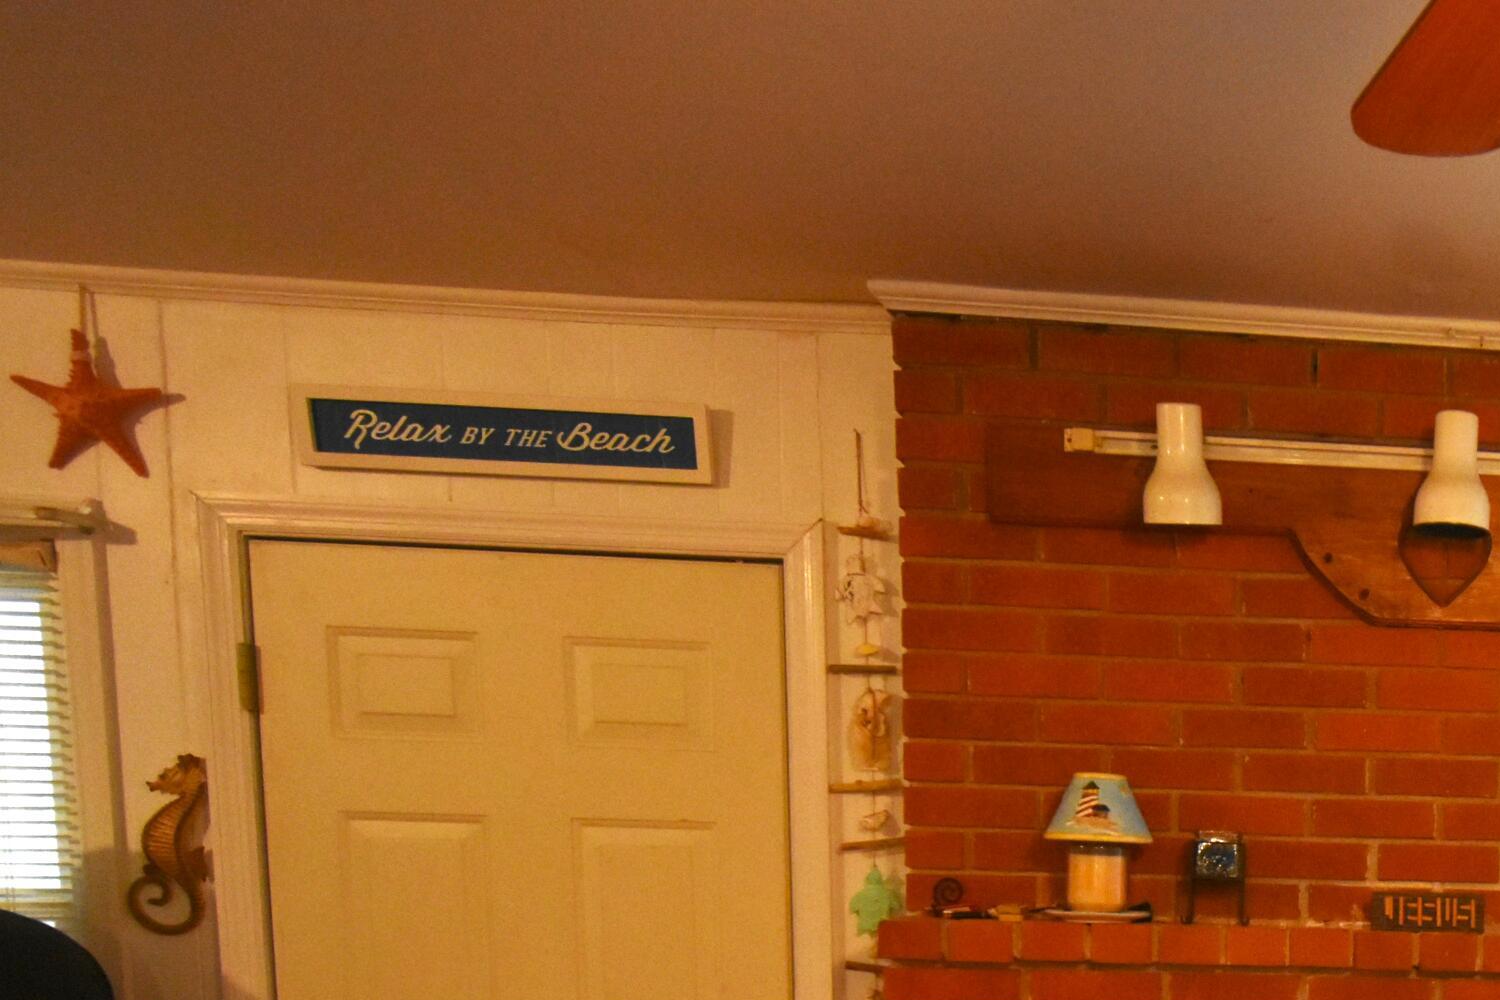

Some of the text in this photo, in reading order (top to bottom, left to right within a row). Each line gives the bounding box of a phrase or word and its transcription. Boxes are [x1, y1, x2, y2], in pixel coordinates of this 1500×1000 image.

[343, 409, 676, 454] Relax BY THE Beach
